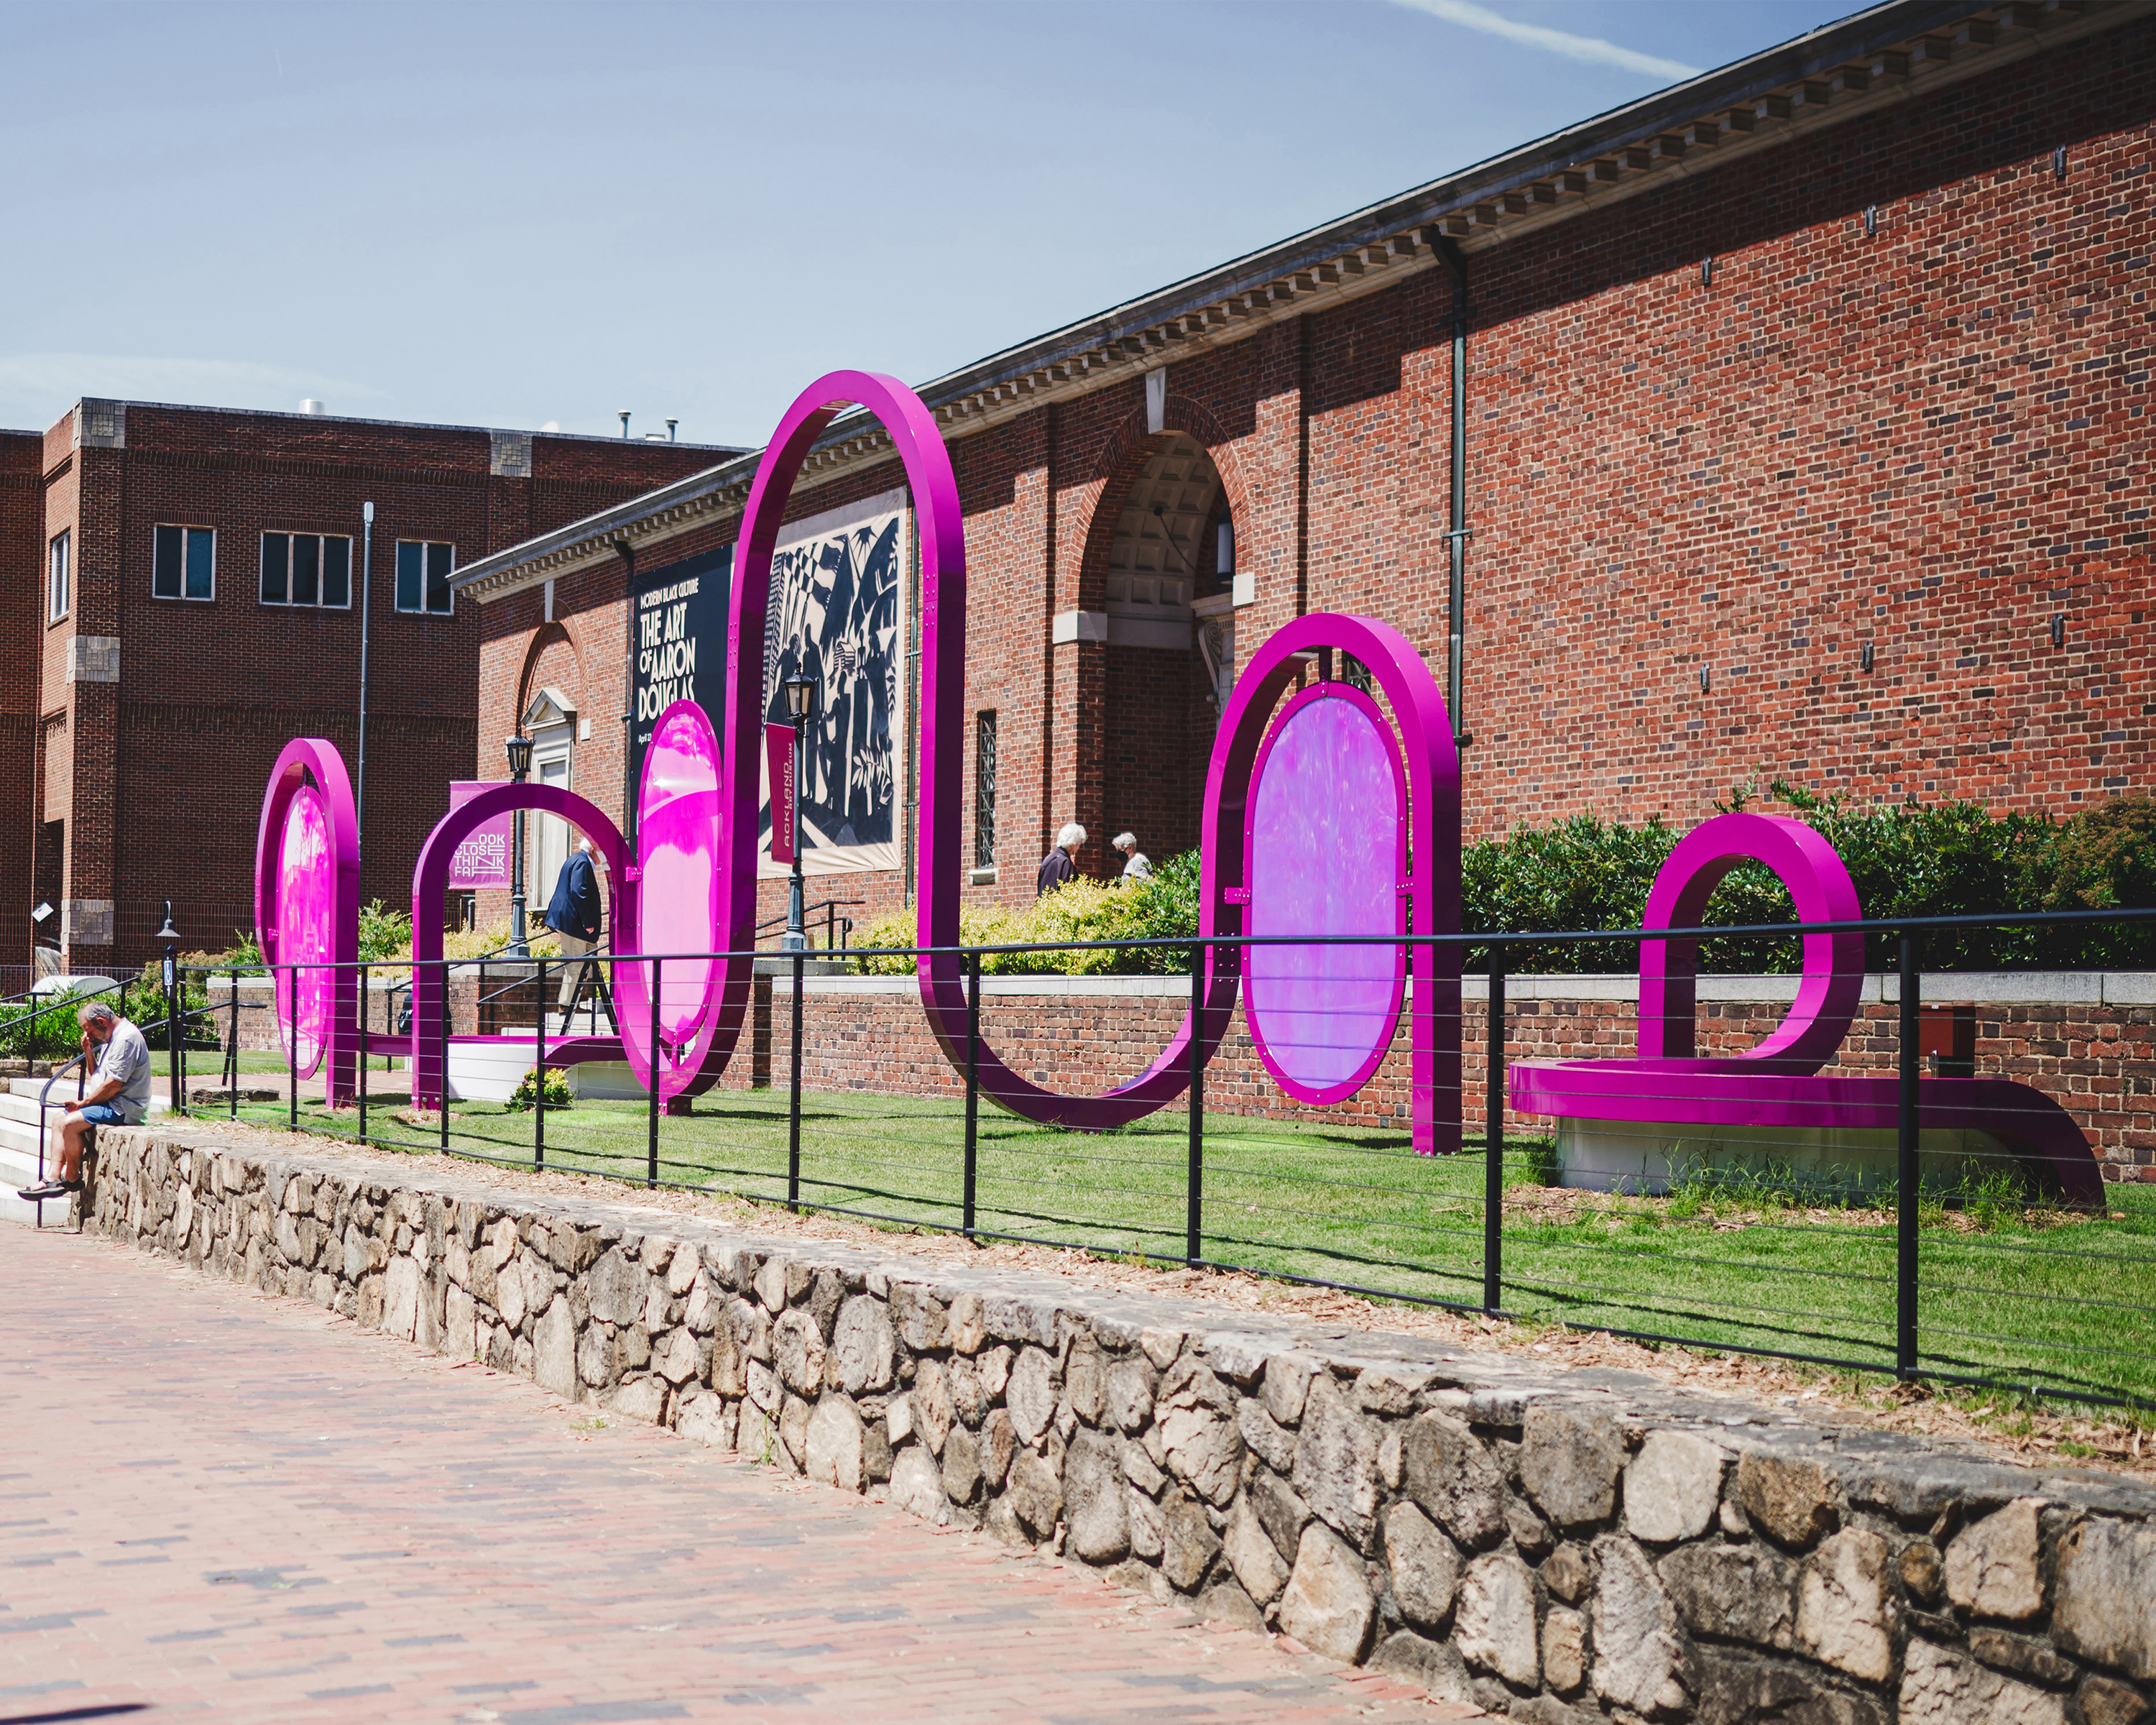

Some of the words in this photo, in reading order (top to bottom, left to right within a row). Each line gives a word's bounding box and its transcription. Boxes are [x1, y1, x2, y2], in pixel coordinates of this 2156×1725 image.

[640, 589, 663, 610] MODERN
[663, 584, 678, 603] BLACK
[678, 577, 699, 597] CULTURE
[640, 610, 662, 649] THE
[663, 602, 688, 643] ART
[639, 649, 653, 674] OF
[650, 637, 696, 684] AARON
[453, 855, 505, 867] THINK
[454, 845, 506, 855] CLOSE
[454, 866, 505, 878] FAR
